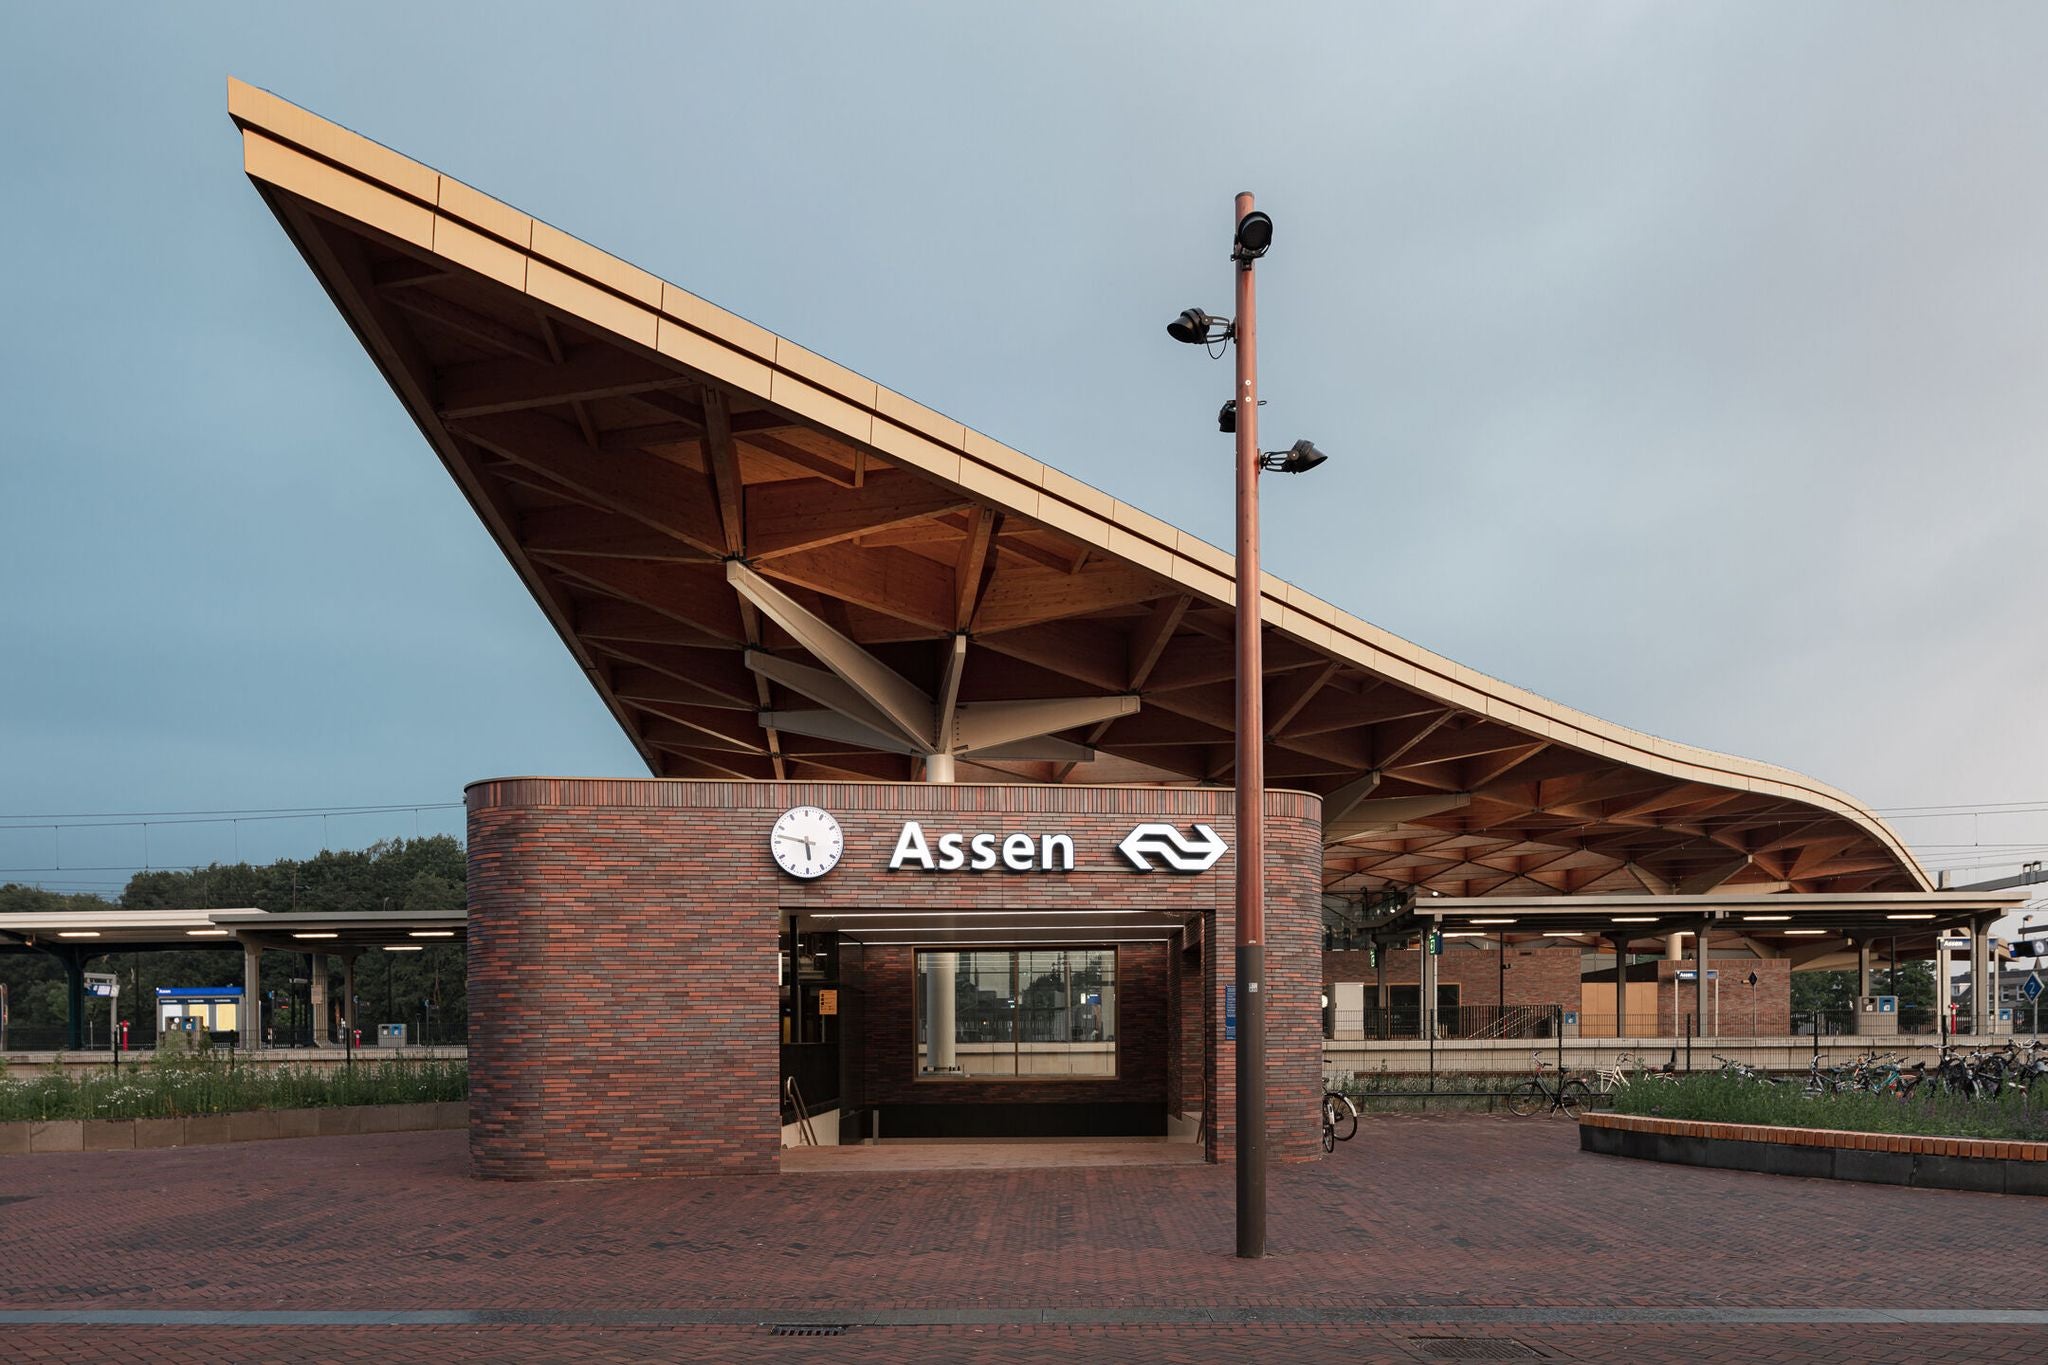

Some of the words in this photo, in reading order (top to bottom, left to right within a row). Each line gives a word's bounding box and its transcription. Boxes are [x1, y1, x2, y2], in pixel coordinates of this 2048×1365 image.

[888, 820, 1076, 871] Assen
[1943, 940, 1964, 948] Assen
[2029, 982, 2036, 994] 2
